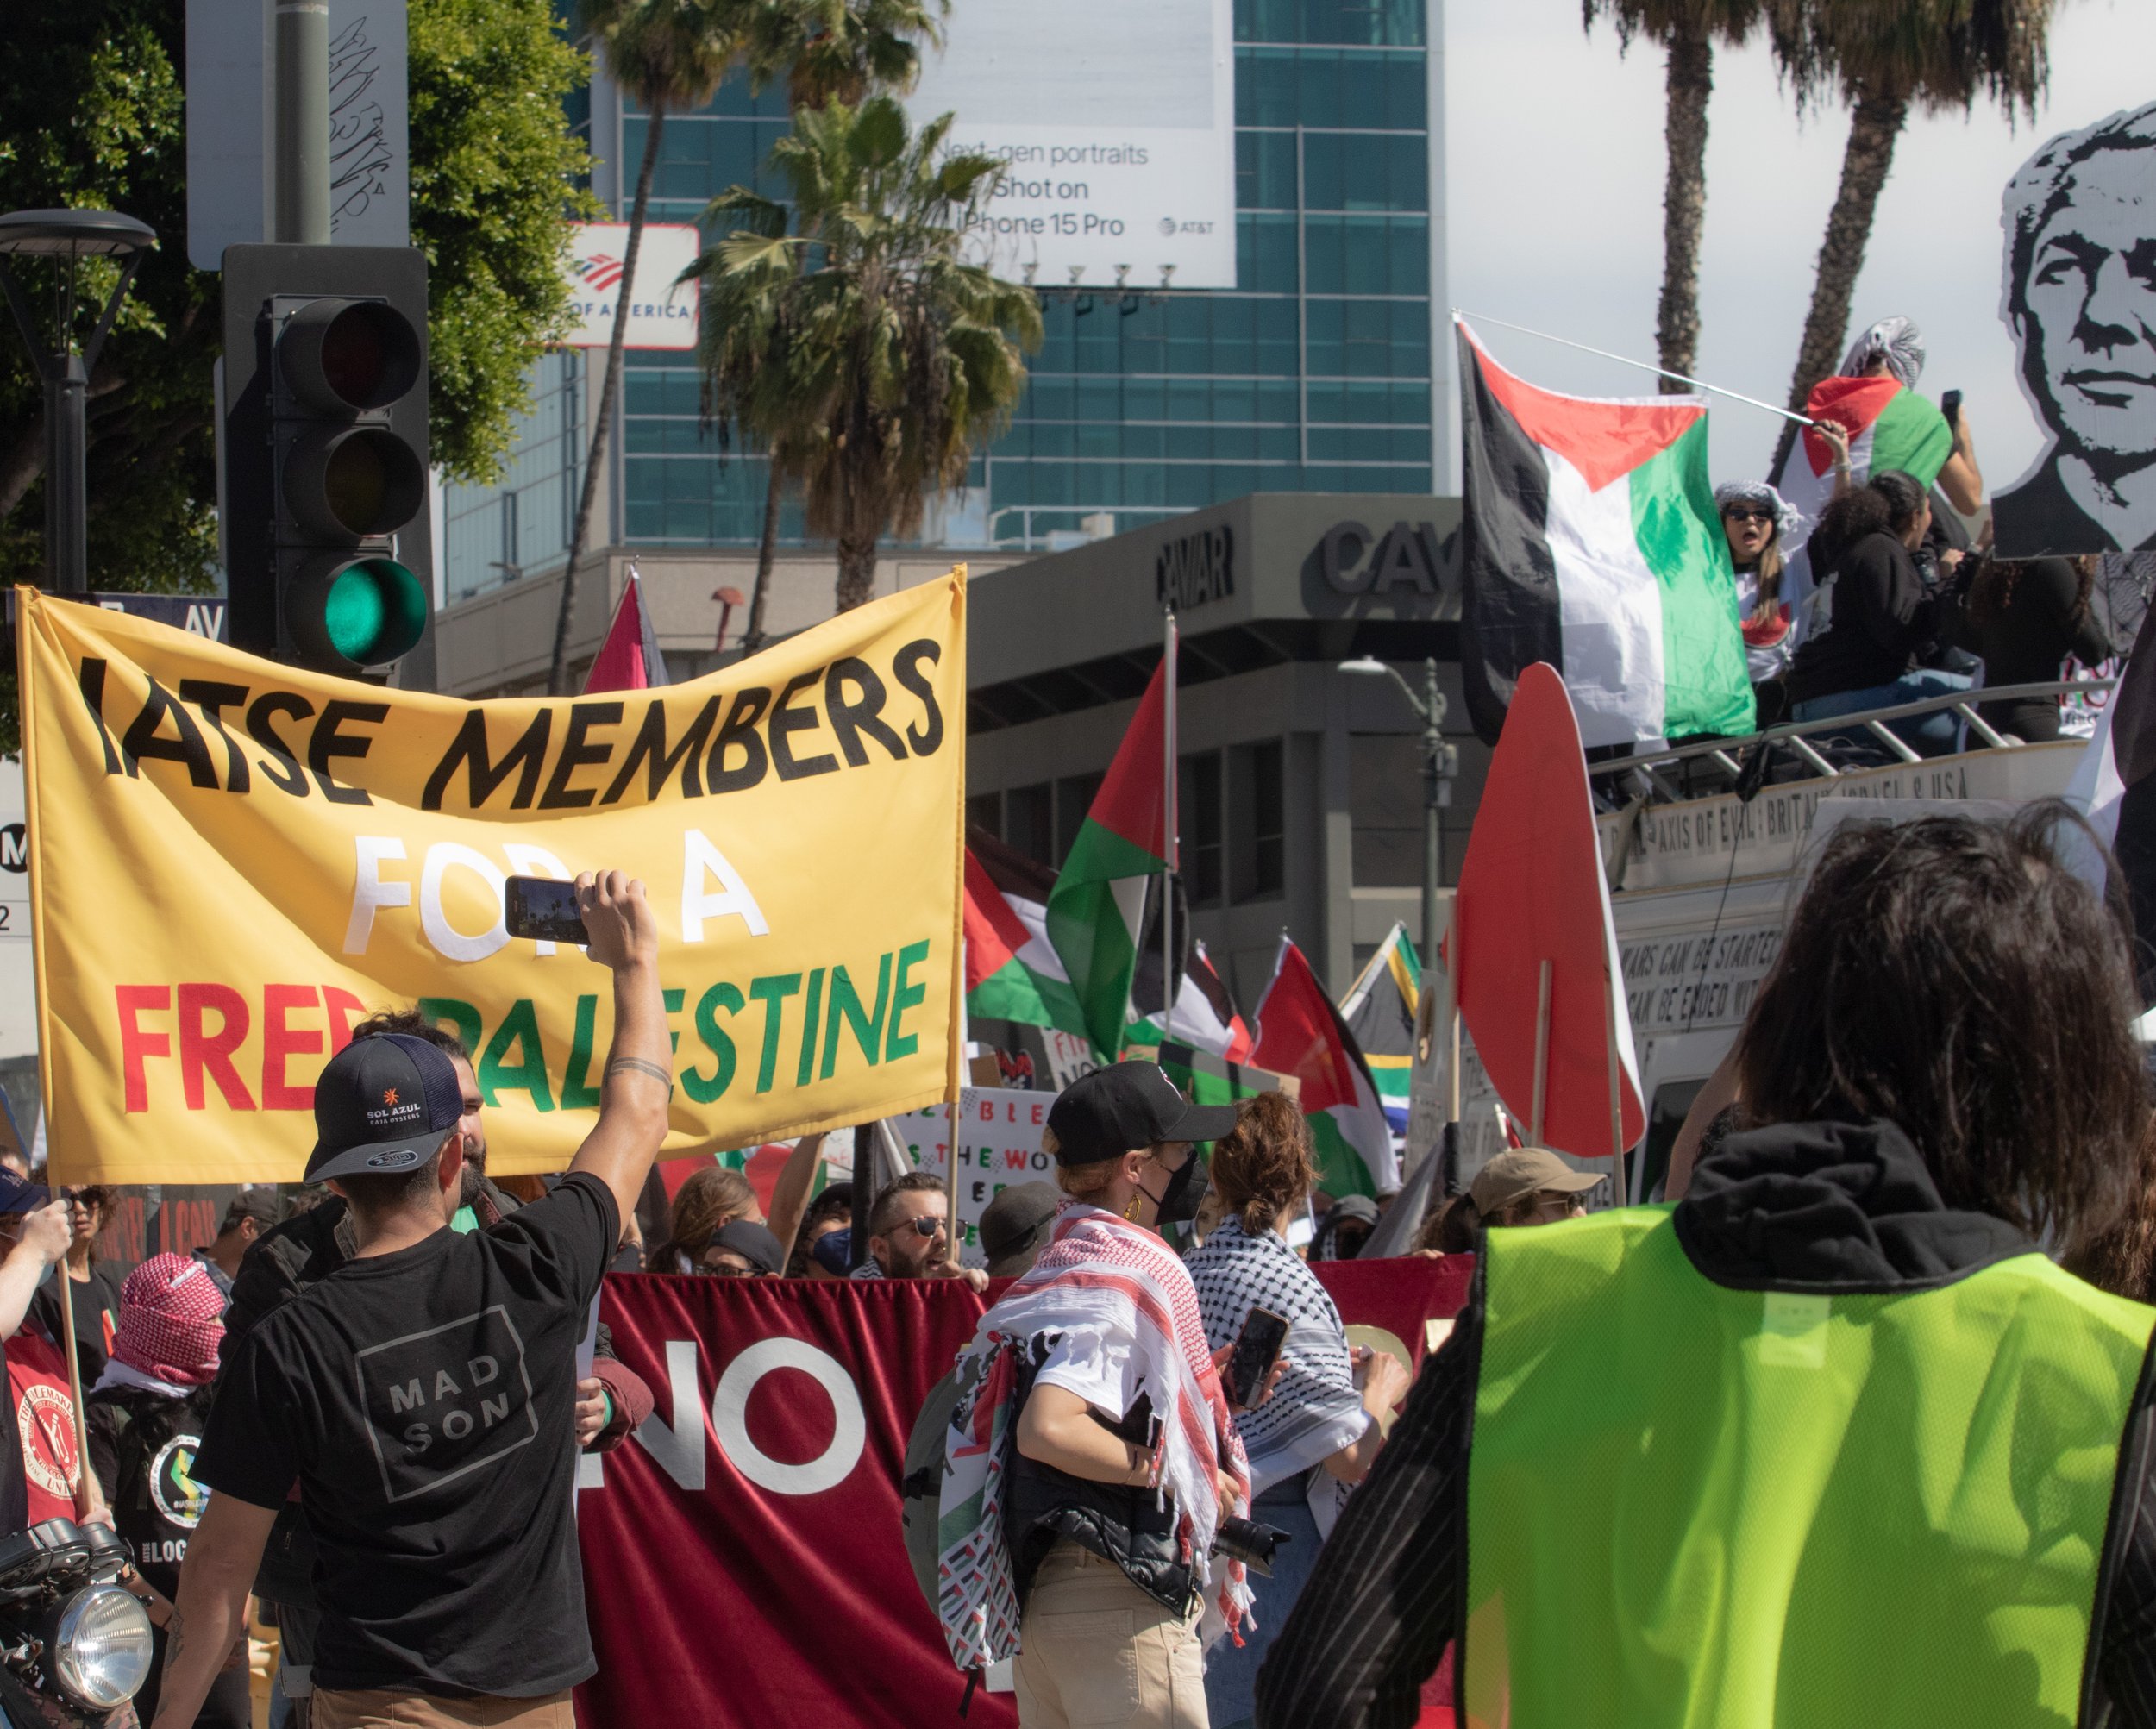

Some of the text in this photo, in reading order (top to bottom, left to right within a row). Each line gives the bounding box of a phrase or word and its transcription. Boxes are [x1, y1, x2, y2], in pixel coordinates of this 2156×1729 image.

[1050, 142, 1150, 167] portraits
[993, 177, 1089, 199] Shot on
[956, 206, 1125, 236] iPhone 15 Pro
[1179, 222, 1214, 235] AT&T
[599, 304, 689, 318] AERICA
[185, 605, 224, 642] AV
[79, 637, 944, 811] IATSE MEMBERS
[1696, 811, 1714, 847] OF
[682, 830, 770, 943] A
[367, 1103, 421, 1119] SOL AZUL
[389, 1354, 499, 1414] MAD
[404, 1391, 510, 1456] SON
